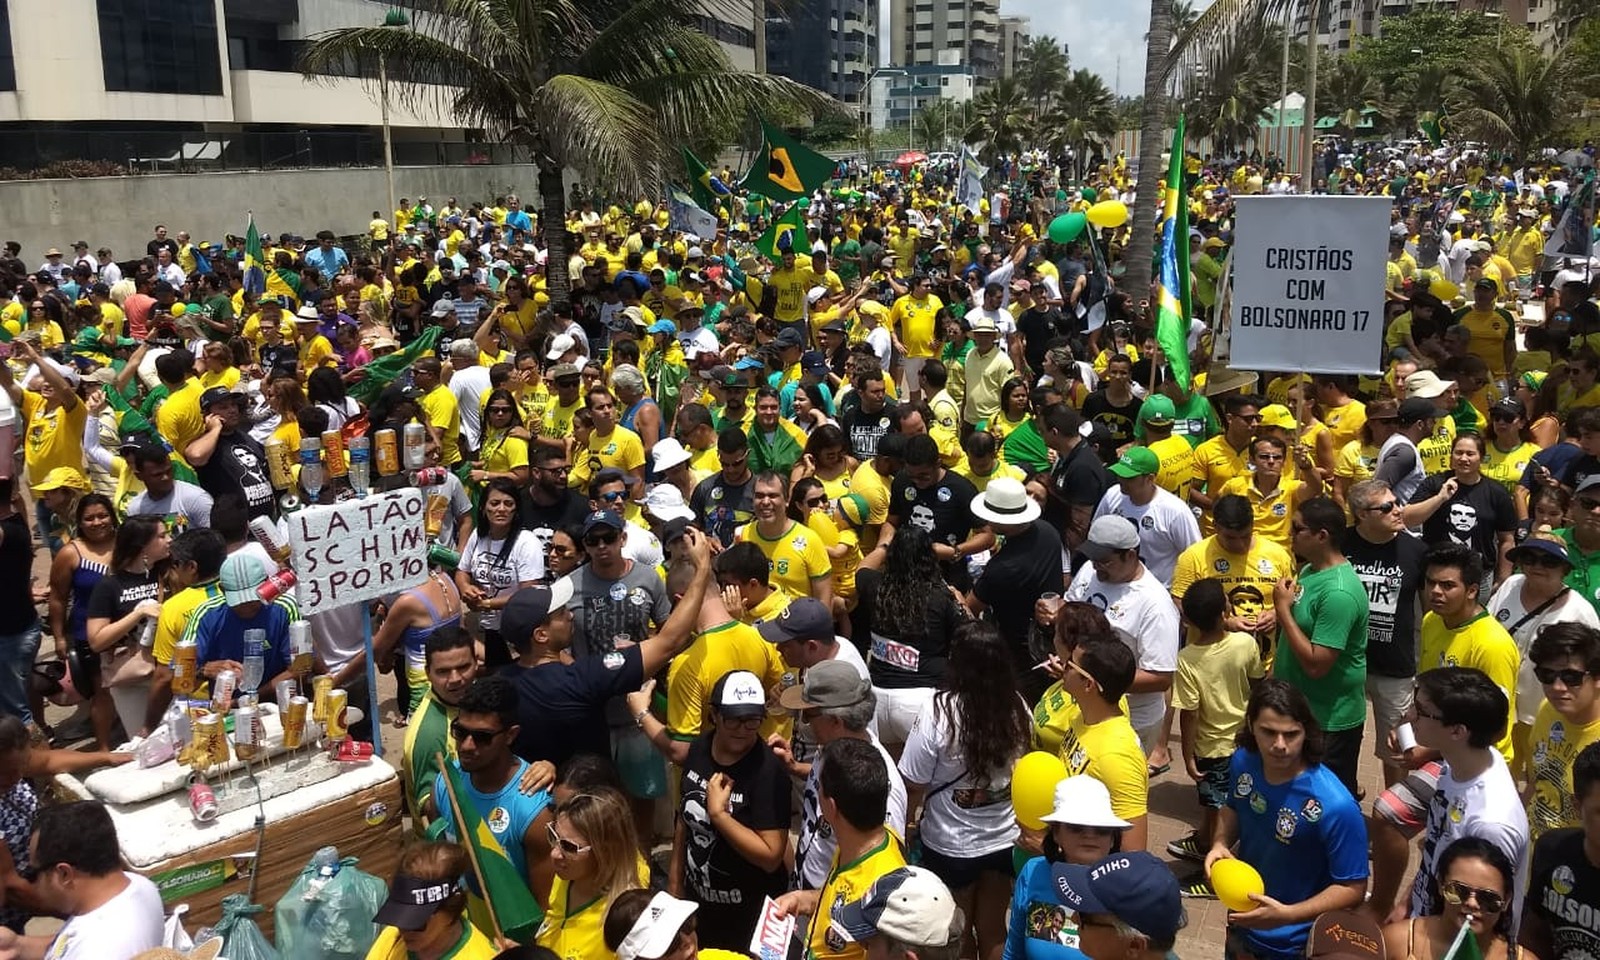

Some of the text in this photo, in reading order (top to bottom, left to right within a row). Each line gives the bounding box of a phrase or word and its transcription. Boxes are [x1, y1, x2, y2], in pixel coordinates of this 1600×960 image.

[1266, 245, 1353, 271] CRISTÃOS
[1286, 278, 1325, 300] COM
[1240, 306, 1370, 331] BOLSONARO 17
[122, 582, 160, 596] ACABOU
[1091, 858, 1130, 880] CHILE
[1058, 876, 1083, 906] CHILE
